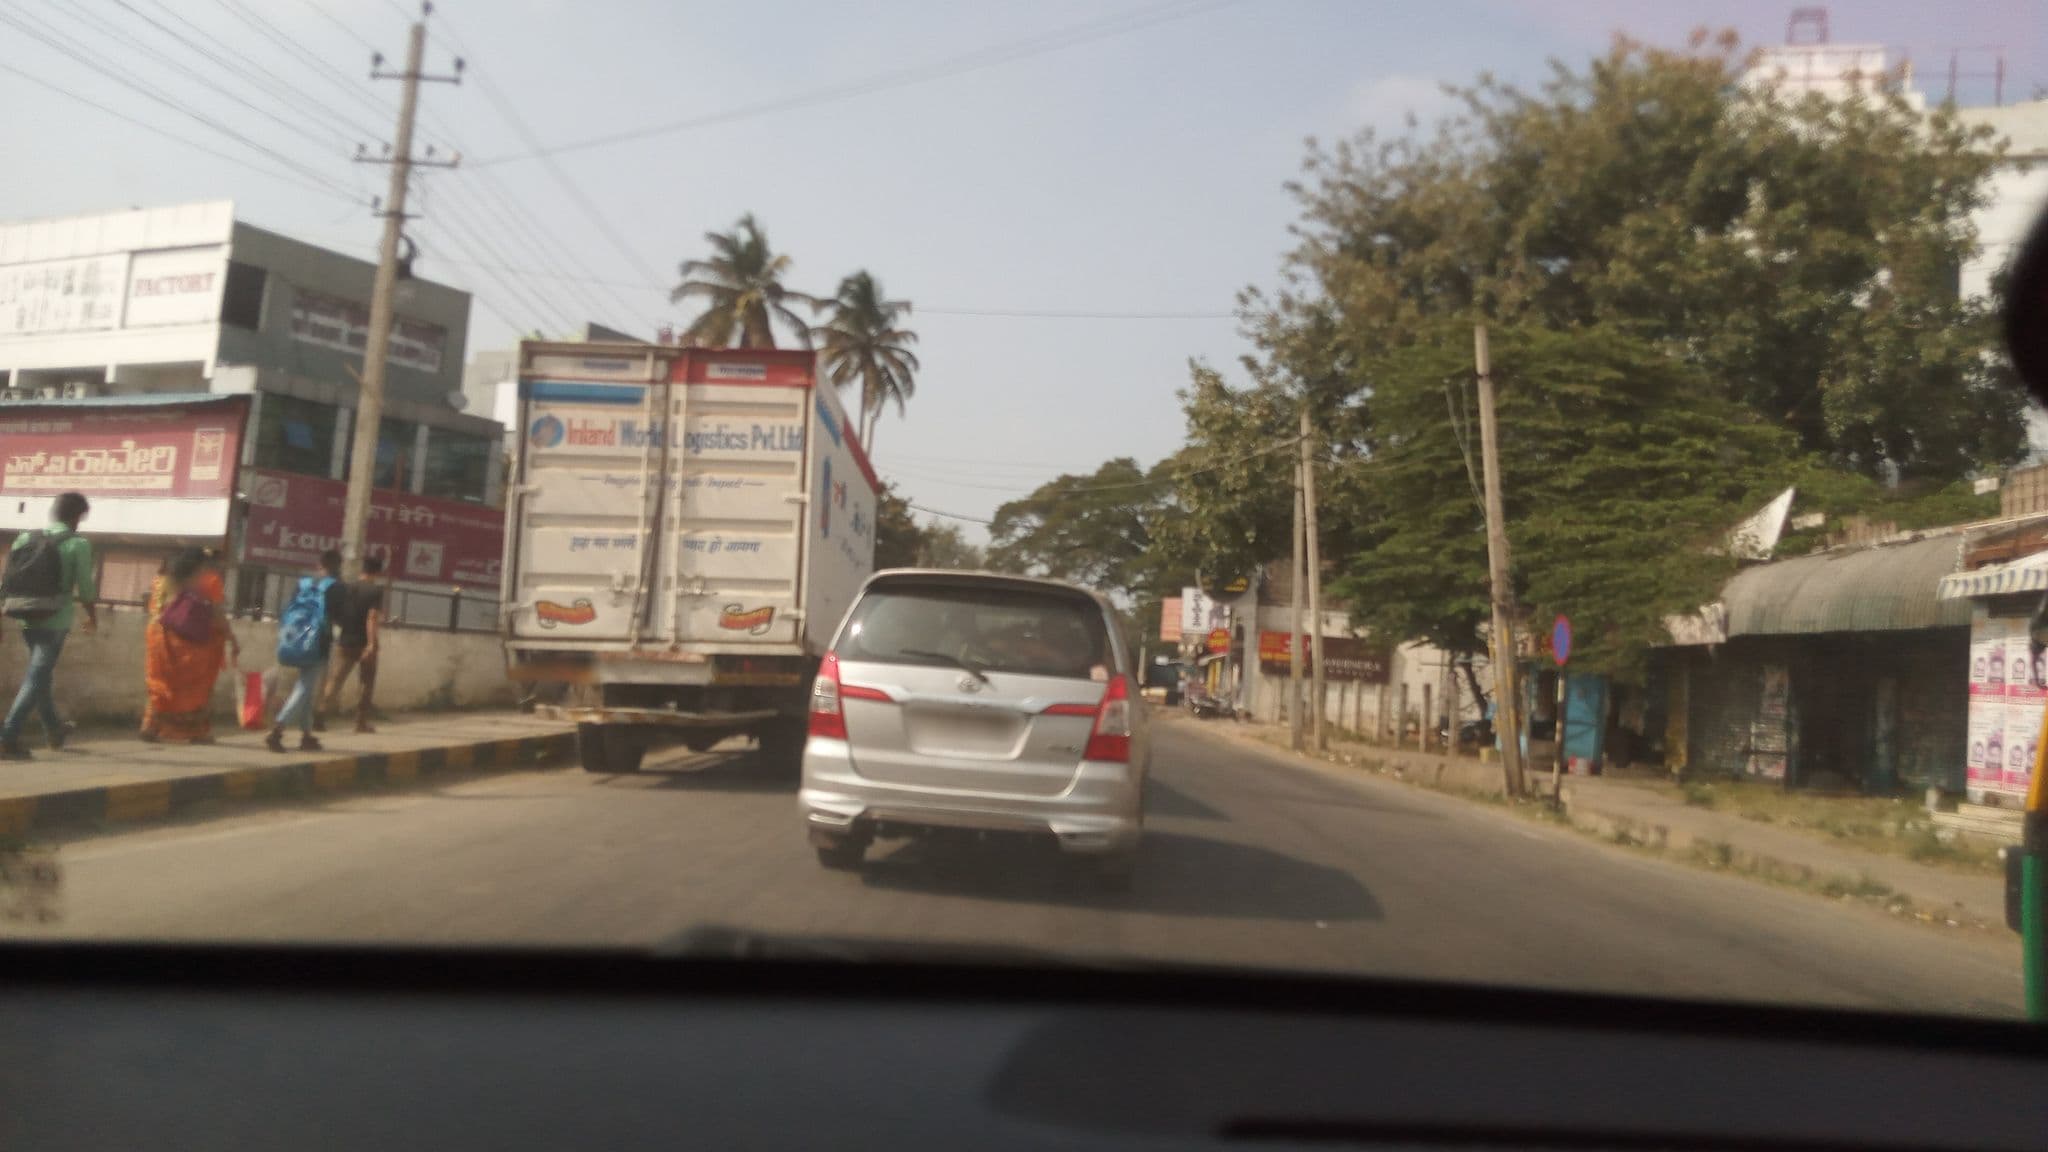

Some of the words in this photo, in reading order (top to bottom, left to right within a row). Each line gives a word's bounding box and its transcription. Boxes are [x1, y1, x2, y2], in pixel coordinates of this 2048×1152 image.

[135, 272, 216, 297] FACTORY
[566, 418, 616, 447] Inland
[670, 421, 749, 454] Logistics
